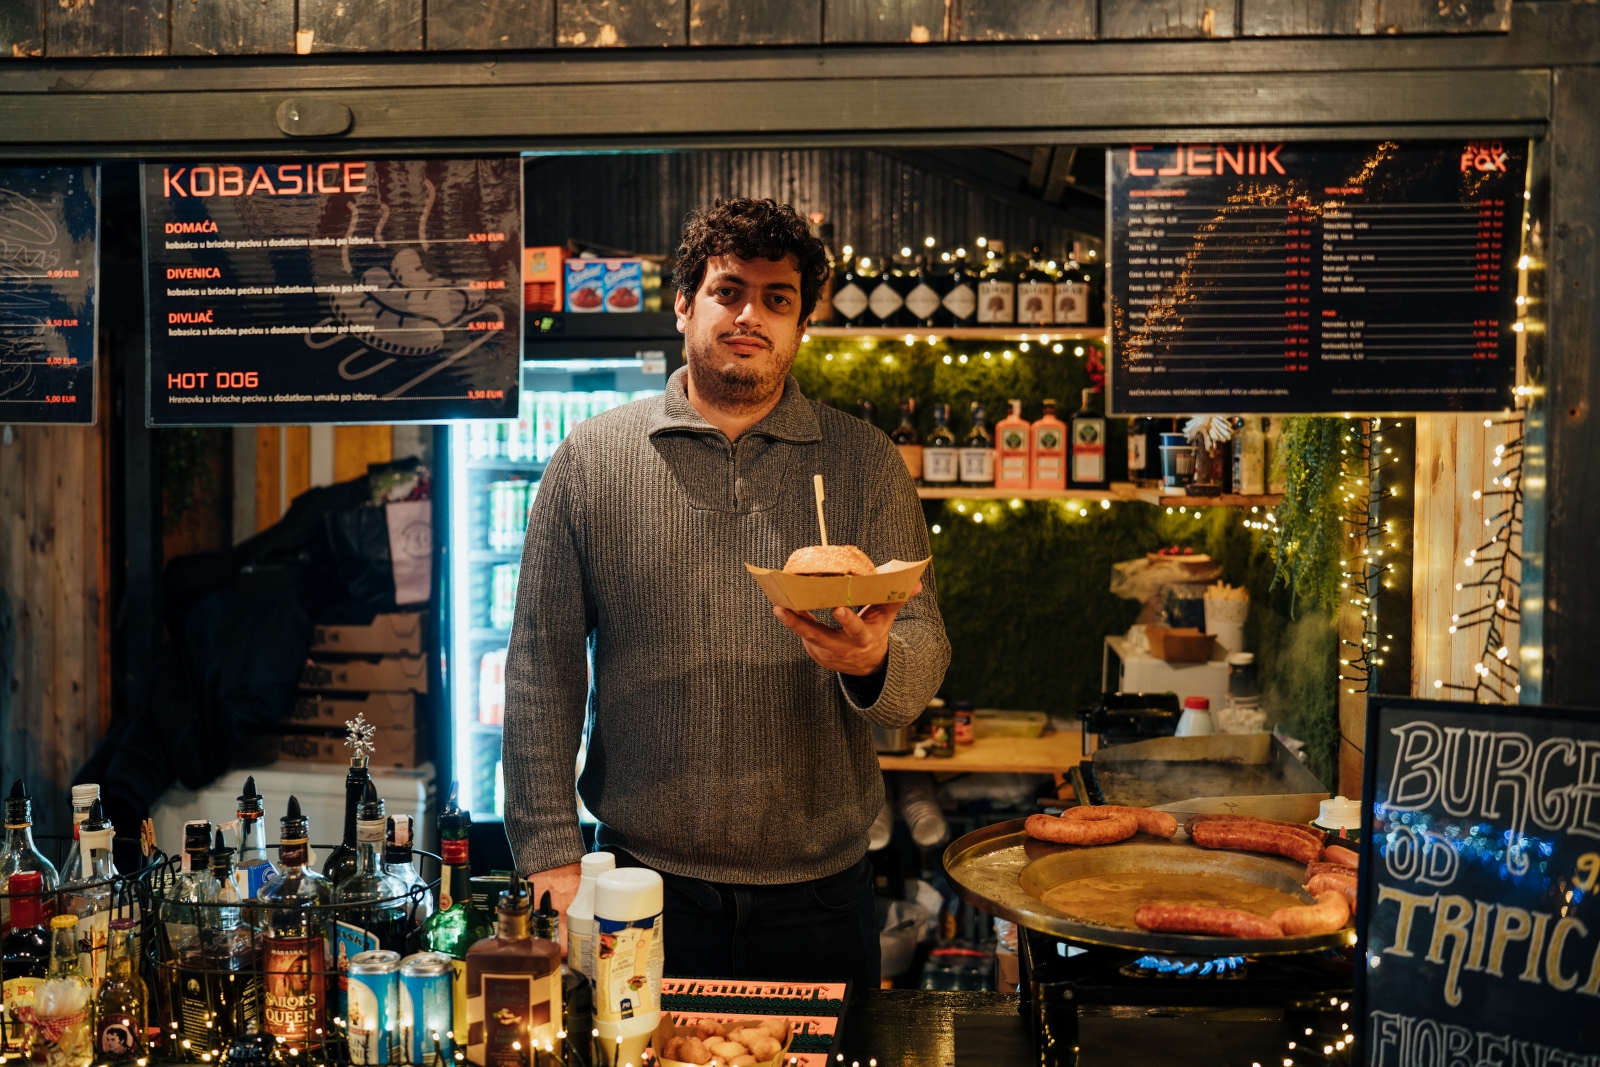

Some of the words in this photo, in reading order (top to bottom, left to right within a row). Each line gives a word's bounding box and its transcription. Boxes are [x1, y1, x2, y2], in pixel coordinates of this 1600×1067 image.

[1128, 142, 1287, 177] CJENIK
[1460, 152, 1508, 172] FOX
[163, 162, 368, 198] KOBASICE
[165, 219, 219, 234] DOMAĆA
[165, 240, 199, 250] kobasica
[199, 241, 205, 249] u
[206, 239, 236, 249] brioche
[236, 239, 262, 249] pecivu
[268, 238, 308, 248] dodatkom
[308, 237, 336, 247] umaka
[336, 238, 348, 247] po
[487, 232, 505, 242] EUR
[46, 270, 64, 279] 9,00
[64, 270, 79, 278] EUR
[166, 267, 222, 280] DIVENICA
[167, 287, 200, 297] kobasica
[207, 286, 237, 296] brioche
[237, 286, 263, 296] pecivu
[264, 287, 273, 295] sa
[274, 285, 313, 294] dodatkom
[314, 284, 341, 294] umaka
[342, 285, 352, 294] po
[488, 280, 506, 289] EUR
[63, 318, 78, 326] EUR
[168, 309, 214, 324] DIVLJAČ
[1322, 320, 1348, 328] Heineken
[168, 328, 200, 337] kobasica
[208, 328, 238, 336] brioche
[238, 327, 264, 336] pecivu
[270, 326, 310, 335] dodatkom
[310, 325, 338, 334] umaka
[338, 326, 349, 335] po
[487, 321, 504, 330] EUR
[46, 358, 62, 366] 9,00
[168, 372, 209, 390] HOT
[216, 372, 260, 388] DOG
[45, 396, 62, 404] 5,00
[62, 395, 76, 403] EUR
[168, 395, 204, 404] Hrenovka
[212, 394, 241, 404] brioche
[242, 394, 268, 404] pecivu
[274, 393, 313, 402] dodatkom
[314, 392, 340, 402] umaka
[340, 394, 352, 403] po
[486, 390, 504, 398] EUR
[1385, 824, 1459, 887] OD
[265, 1008, 317, 1026] QUEEN
